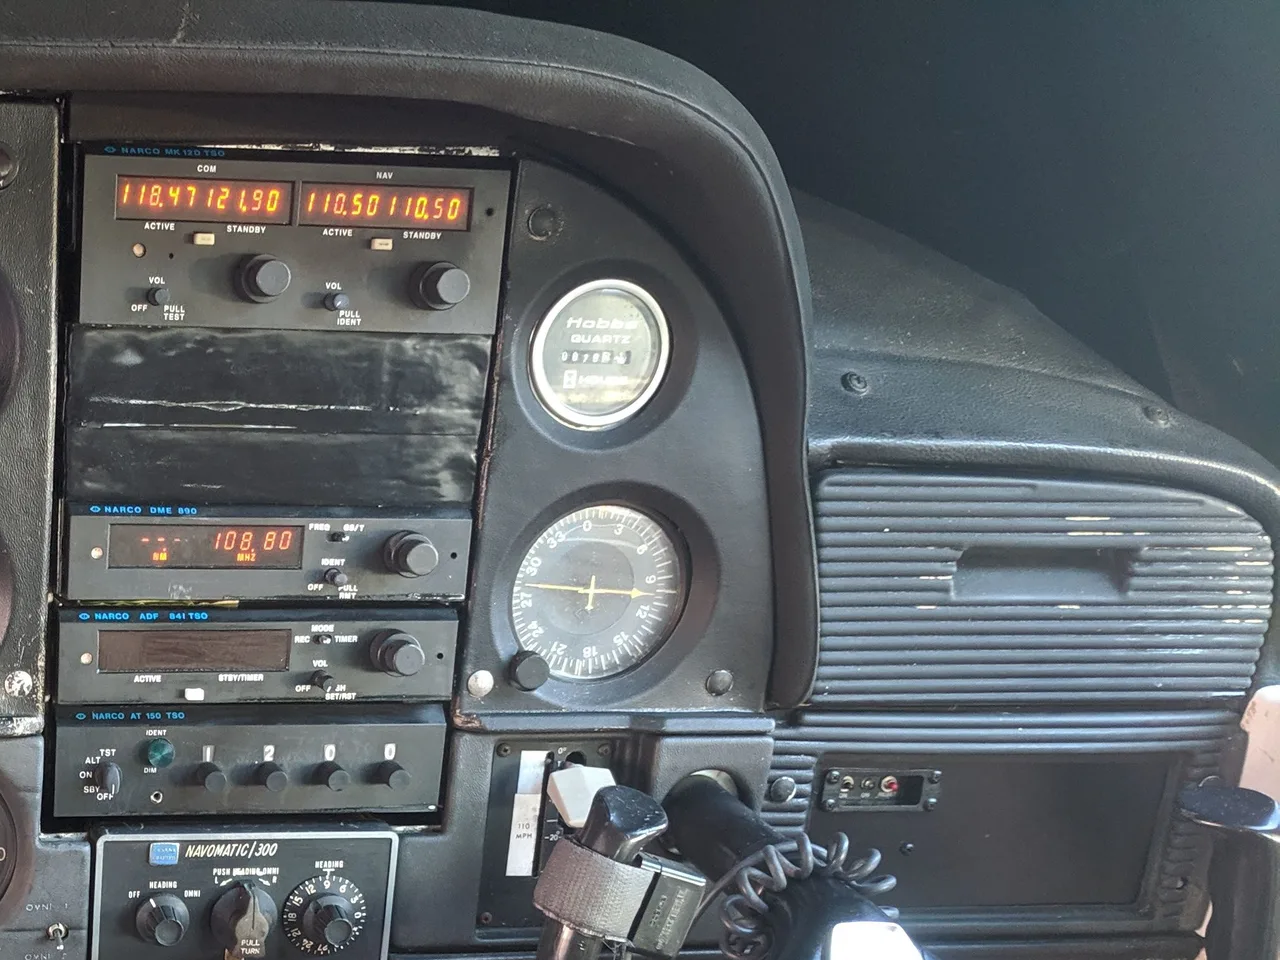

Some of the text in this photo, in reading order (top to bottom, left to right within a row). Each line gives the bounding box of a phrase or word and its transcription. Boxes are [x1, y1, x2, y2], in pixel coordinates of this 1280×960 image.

[121, 147, 160, 155] NARCO
[165, 148, 180, 156] MK
[204, 149, 225, 157] TSO
[197, 165, 217, 173] COM
[376, 171, 393, 179] NAV
[123, 183, 280, 213] 118.47 121.90
[307, 192, 461, 220] 110.50 110.50
[144, 222, 175, 231] ACTIVE
[227, 225, 266, 234] STANDBY
[323, 229, 353, 237] ACTIVE
[403, 231, 442, 240] STANDBY
[149, 277, 165, 285] VOL
[325, 282, 342, 290] VOL
[131, 304, 148, 312] OFF
[164, 305, 185, 313] PULL
[164, 313, 185, 321] TEST
[339, 310, 360, 319] PULL
[337, 318, 362, 326] IDENT
[570, 334, 631, 344] QUARTZ
[104, 506, 141, 514] NARCO
[214, 531, 293, 552] 108.80
[546, 530, 567, 549] 33
[321, 558, 345, 566] IDENT
[525, 557, 542, 577] 30
[307, 583, 324, 591] OFF
[94, 612, 130, 620] NARCO
[139, 612, 159, 620] ADF
[188, 612, 208, 620] TSO
[311, 624, 335, 633] MODE
[294, 636, 310, 644] REC
[312, 660, 328, 668] VOL
[134, 675, 161, 683] ACTIVE
[219, 674, 264, 682] STBY/TIMER
[295, 684, 311, 692] OFF
[92, 712, 185, 720] NARCO AT 150 TSO
[99, 749, 116, 757] TST
[85, 756, 101, 764] ALT
[79, 771, 93, 779] ON
[83, 786, 100, 794] SBY
[517, 822, 531, 830] 110
[185, 842, 279, 859] NAVOMATIC/300
[315, 861, 344, 869] HEADING
[149, 881, 178, 889] HEADING
[184, 890, 201, 898] OMNI
[241, 939, 260, 947] PULL
[240, 947, 260, 955] TURN
